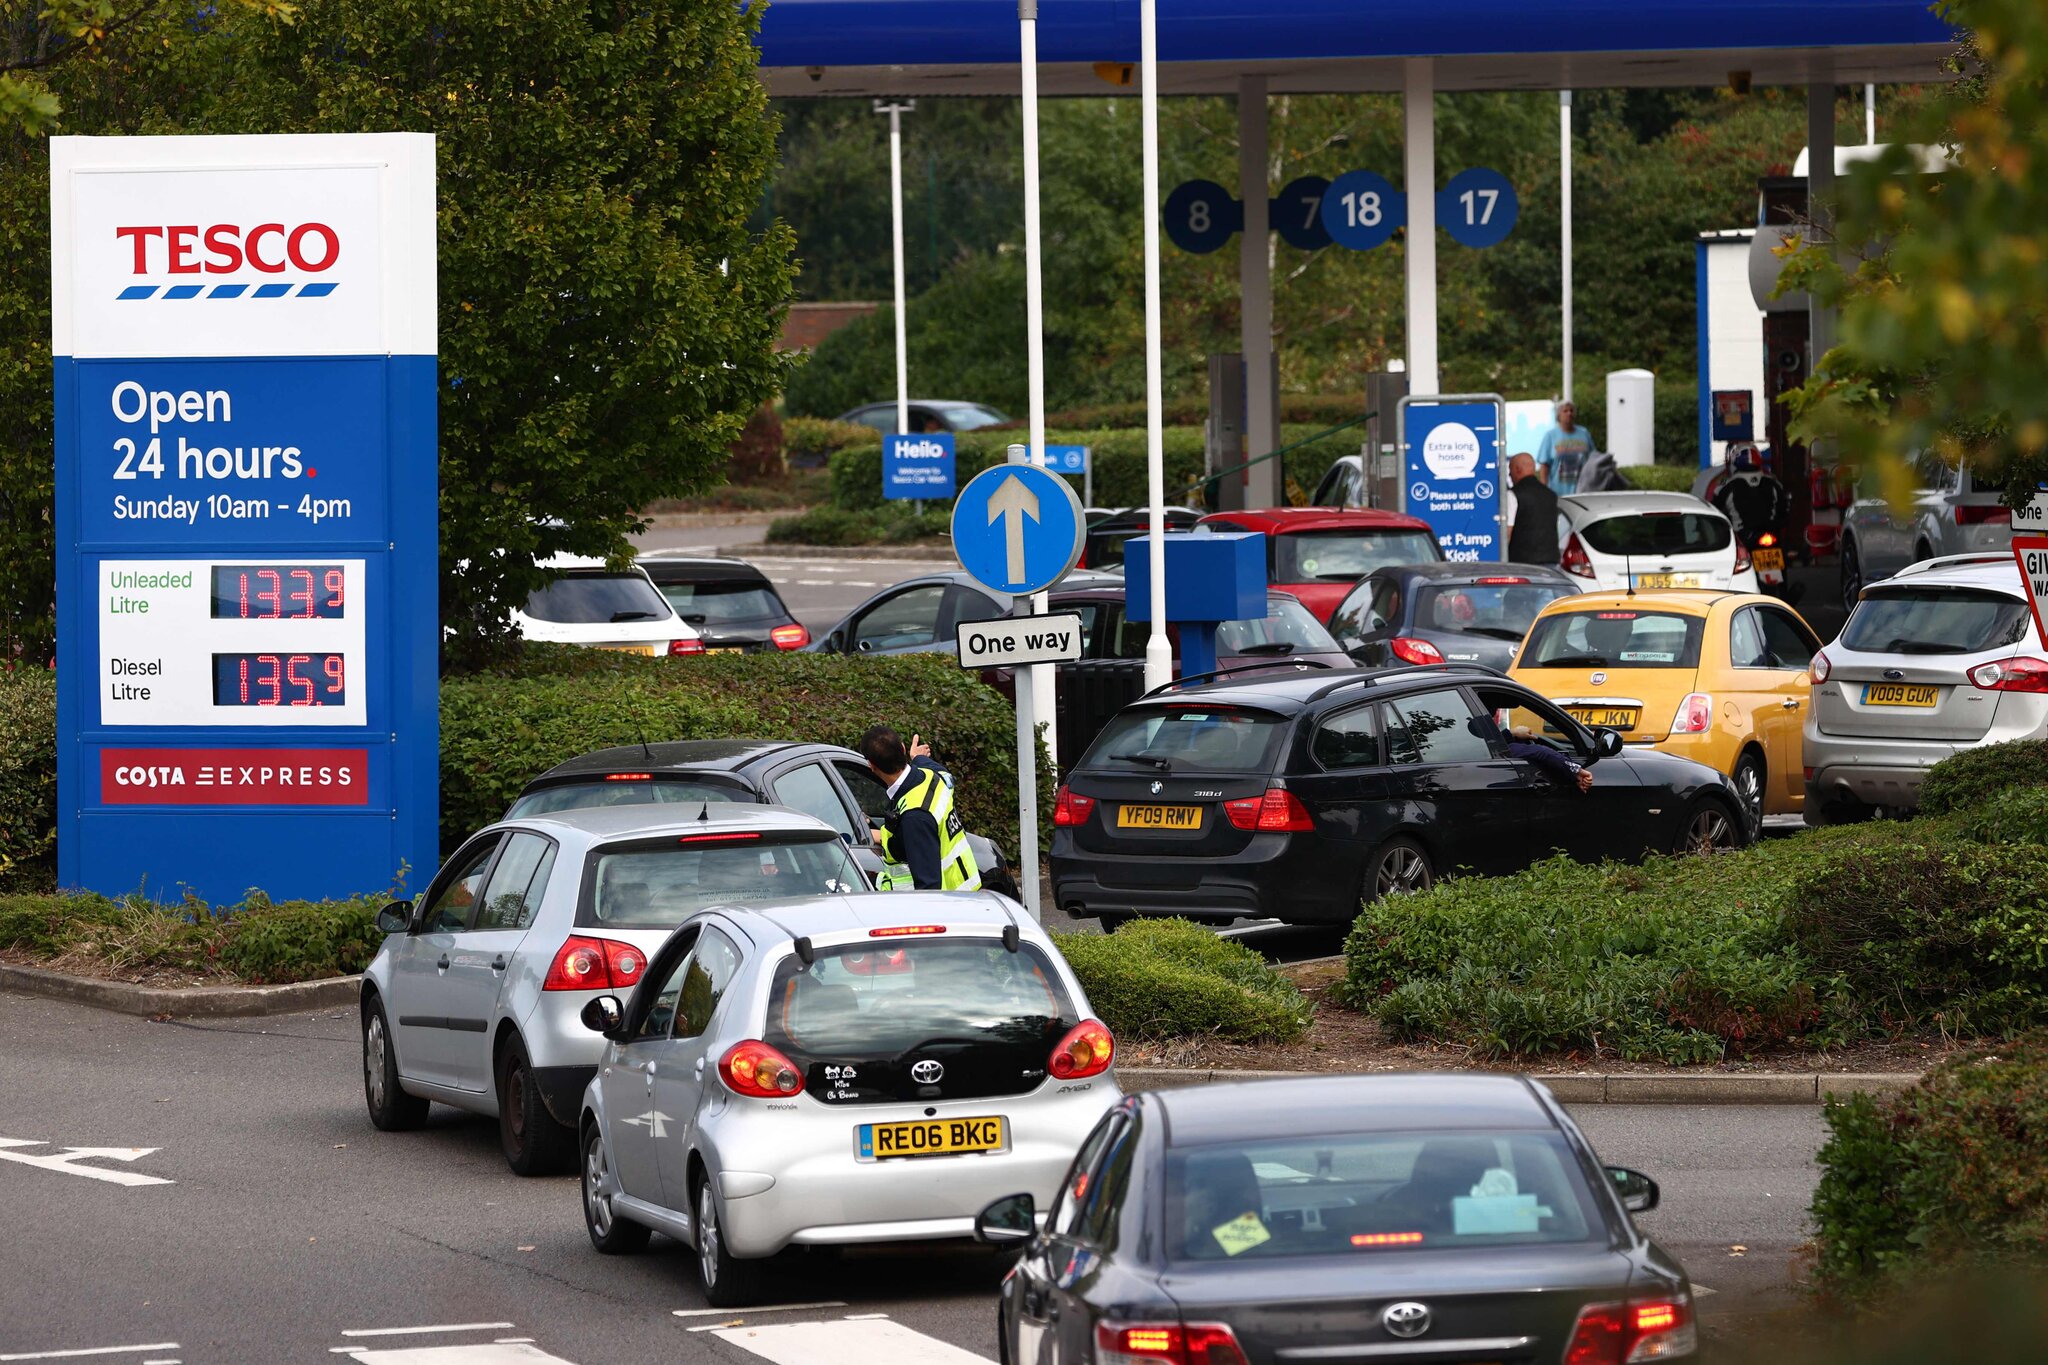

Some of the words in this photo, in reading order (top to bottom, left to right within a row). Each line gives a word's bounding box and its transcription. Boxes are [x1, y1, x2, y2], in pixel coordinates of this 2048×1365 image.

[1302, 197, 1322, 230] 7
[1341, 191, 1382, 227] 18
[1460, 189, 1499, 225] 17
[1188, 200, 1211, 233] 8
[116, 222, 340, 275] TESCO
[111, 381, 231, 434] Open
[1428, 442, 1453, 452] Extra
[1455, 441, 1475, 452] long
[112, 437, 165, 480] 24
[178, 437, 317, 480] hours.
[1438, 453, 1465, 462] hoses
[1430, 491, 1458, 501] Please
[1460, 491, 1475, 500] use
[113, 495, 201, 525] Sunday
[207, 494, 270, 518] 10am
[297, 494, 351, 523] 4pm
[1430, 502, 1451, 512] both
[1452, 501, 1475, 511] sides
[1439, 534, 1452, 547] at
[1455, 532, 1492, 548] Pump
[1445, 549, 1479, 562] Kiosk
[110, 570, 193, 589] Unleaded
[110, 596, 149, 614] Litre
[969, 633, 1016, 654] One
[1025, 631, 1070, 652] way
[111, 658, 162, 676] Diesel
[111, 684, 151, 700] Litre
[1907, 686, 1935, 703] GUK
[1599, 711, 1630, 726] JKN
[115, 766, 186, 788] COSTA
[220, 766, 352, 786] EXPRESS
[1126, 807, 1163, 824] YF09
[1165, 808, 1196, 825] RMV
[1056, 1083, 1092, 1094] AYGO
[767, 1103, 798, 1111] TOYOTA
[878, 1125, 943, 1151] RE06
[950, 1120, 997, 1147] BKG
